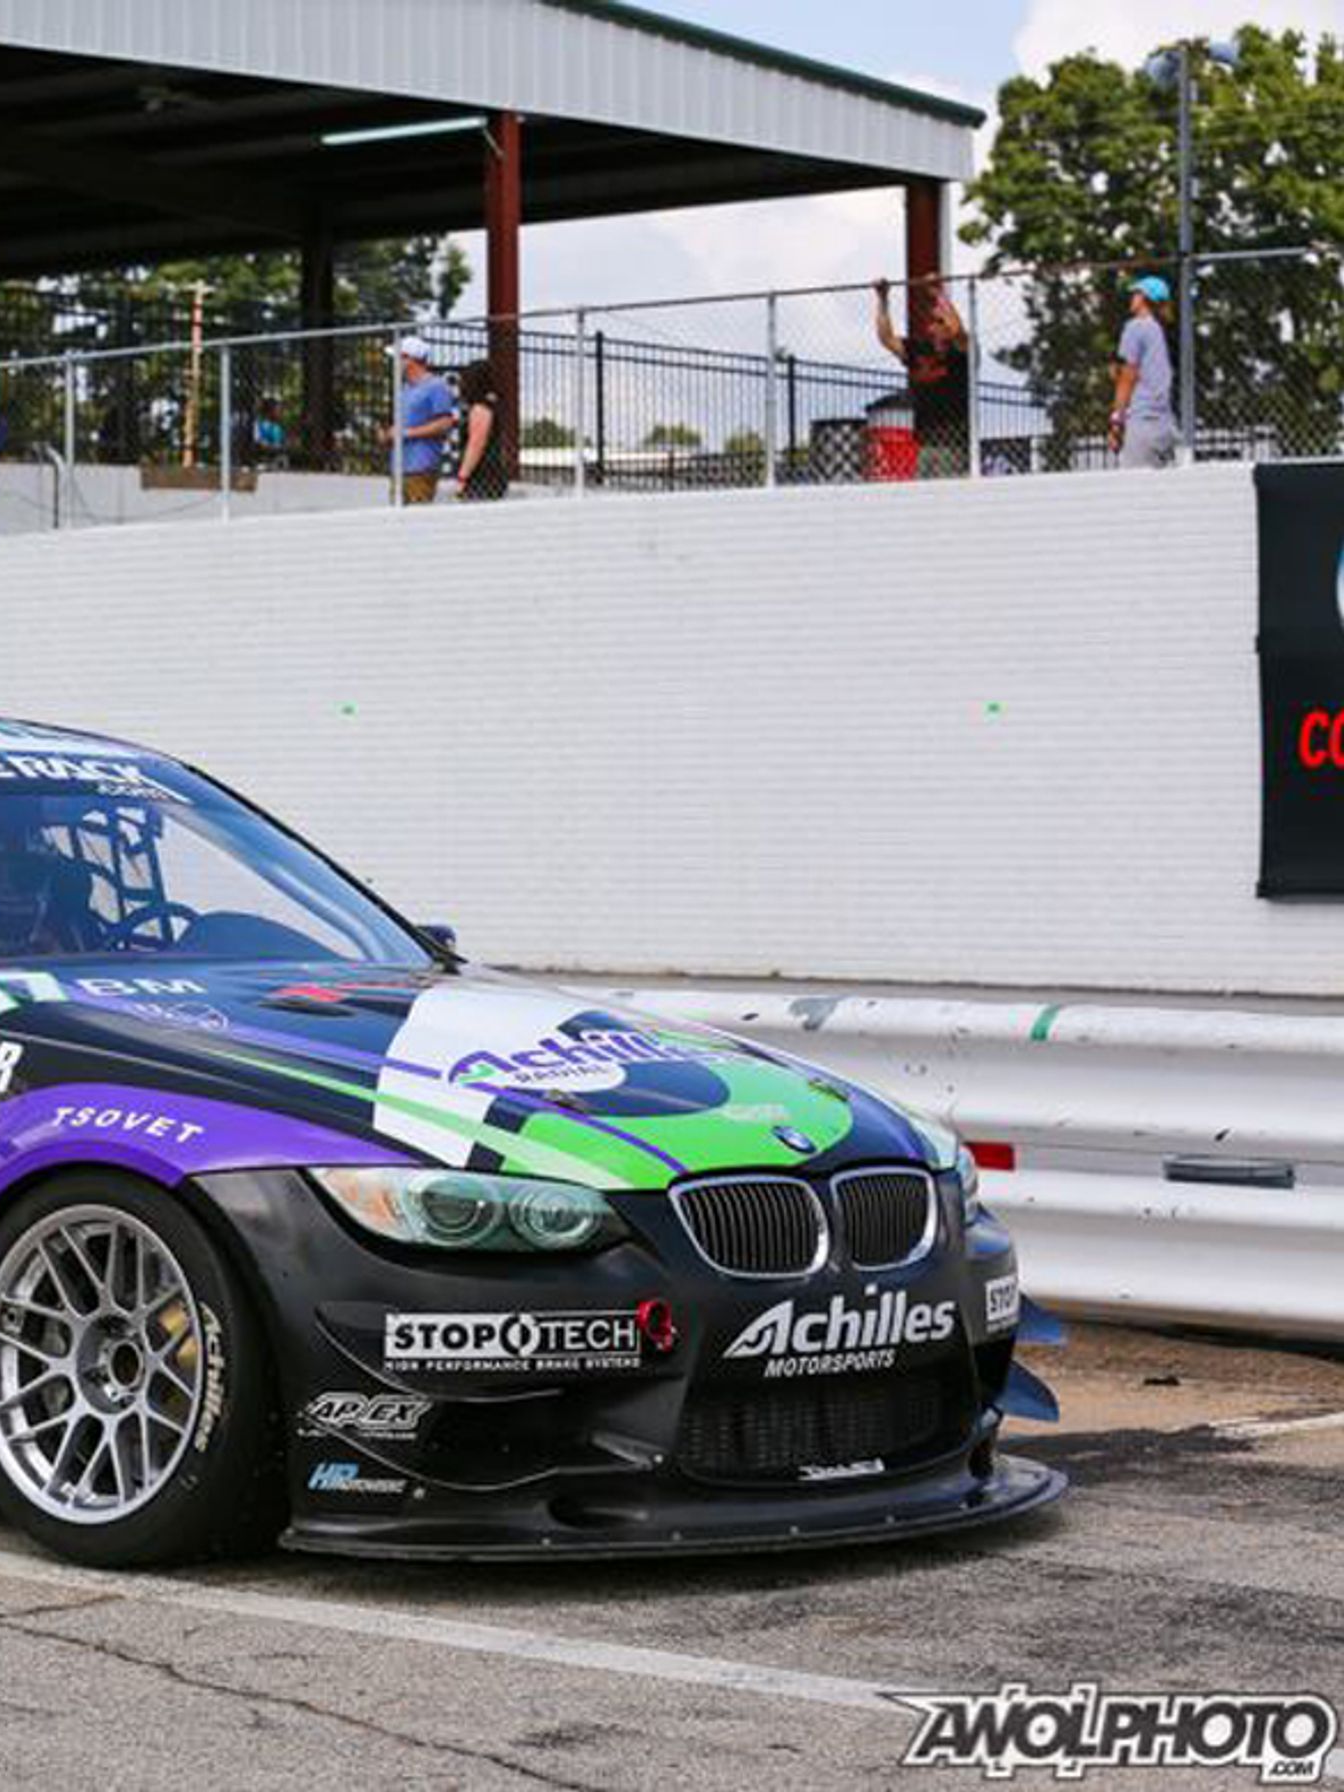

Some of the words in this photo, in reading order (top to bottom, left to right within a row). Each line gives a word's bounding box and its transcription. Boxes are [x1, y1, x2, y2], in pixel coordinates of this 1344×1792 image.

[54, 1107, 204, 1143] TSOVET
[723, 1283, 954, 1359] Achilles
[764, 1349, 895, 1378] MOTORSPORTS
[310, 1396, 428, 1426] APEX
